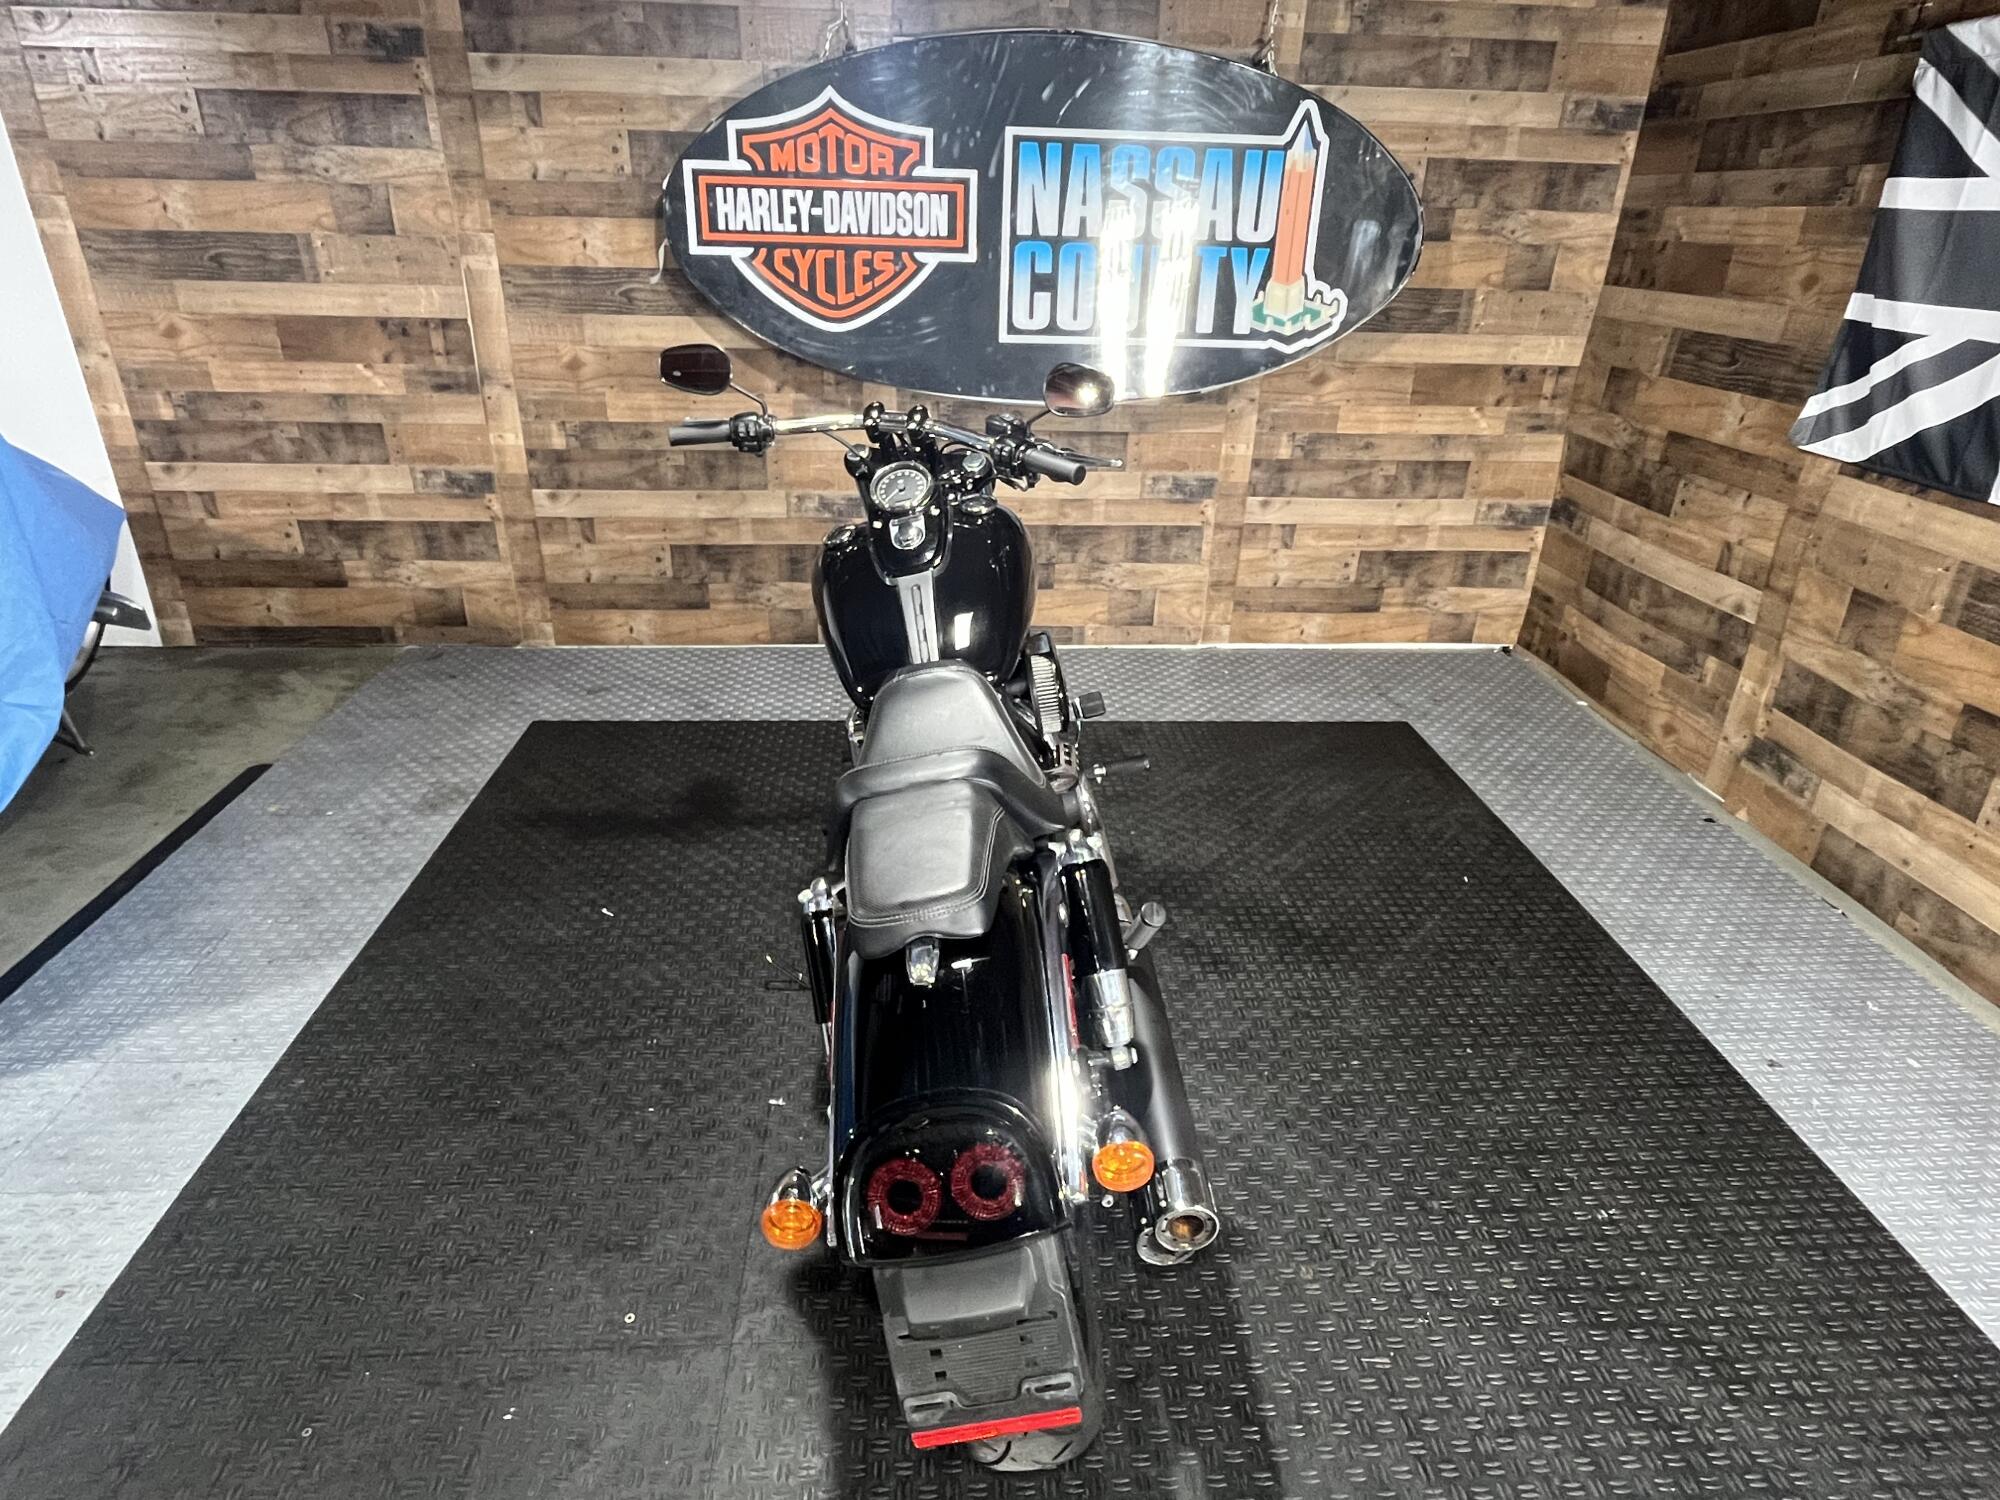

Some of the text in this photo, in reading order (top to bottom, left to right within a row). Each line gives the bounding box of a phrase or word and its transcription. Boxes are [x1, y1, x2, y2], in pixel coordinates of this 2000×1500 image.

[769, 122, 894, 175] MOTOR
[715, 187, 949, 237] HARLEY-DAVIDSON
[1016, 141, 1285, 242] NASSAU
[774, 248, 895, 305] CYCLES
